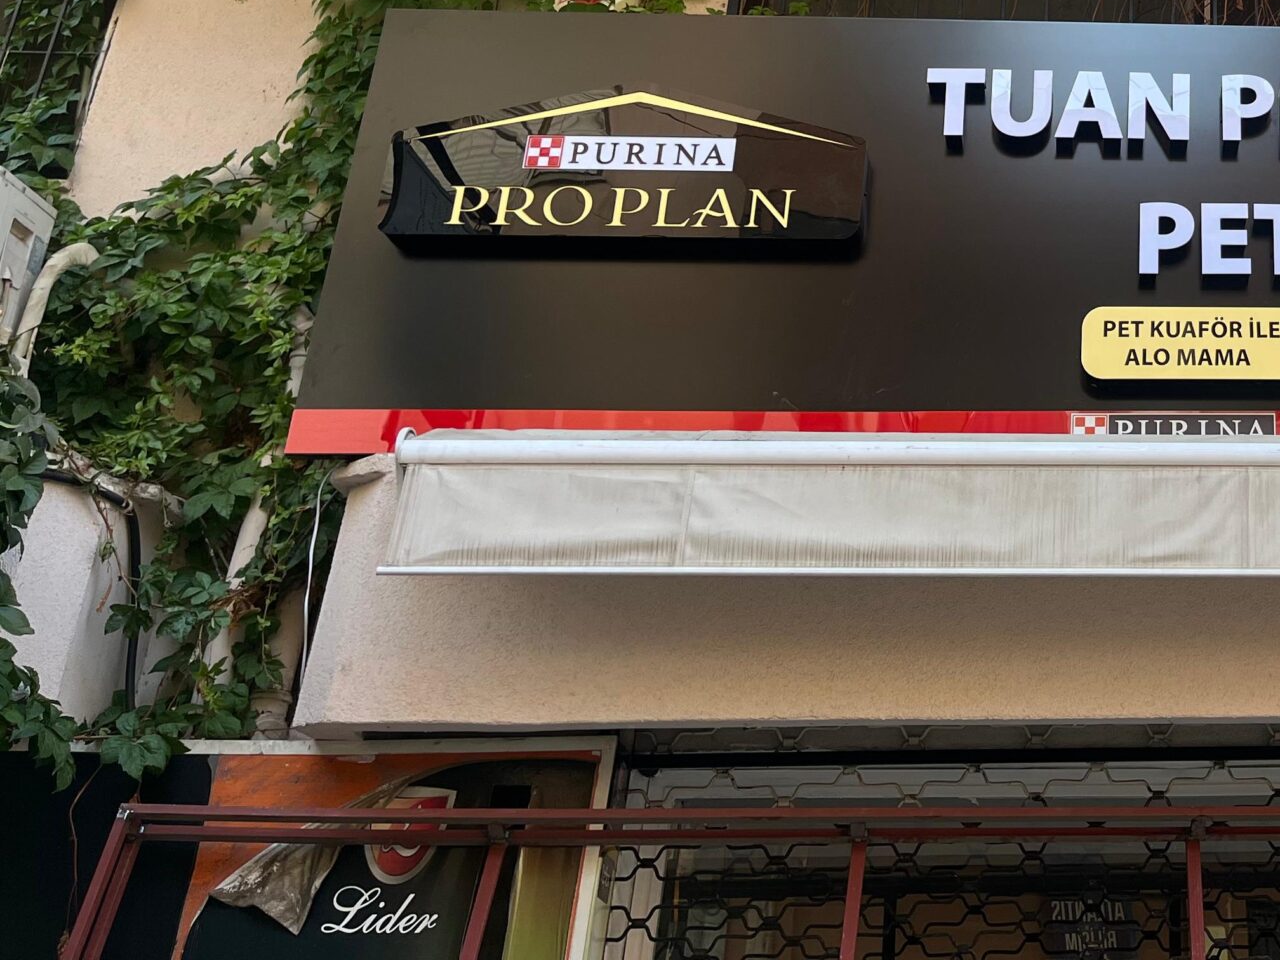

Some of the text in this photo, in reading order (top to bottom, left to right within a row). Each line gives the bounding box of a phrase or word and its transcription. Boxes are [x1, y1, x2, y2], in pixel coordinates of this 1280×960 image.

[927, 68, 1190, 142] TUAN
[570, 142, 726, 166] PURINA
[444, 185, 796, 229] PRO PLAN
[1103, 320, 1144, 338] PET
[1150, 316, 1243, 338] KUAFÖR
[1124, 348, 1171, 366] ALO
[1176, 348, 1251, 366] MAMA
[320, 885, 439, 935] Lider
